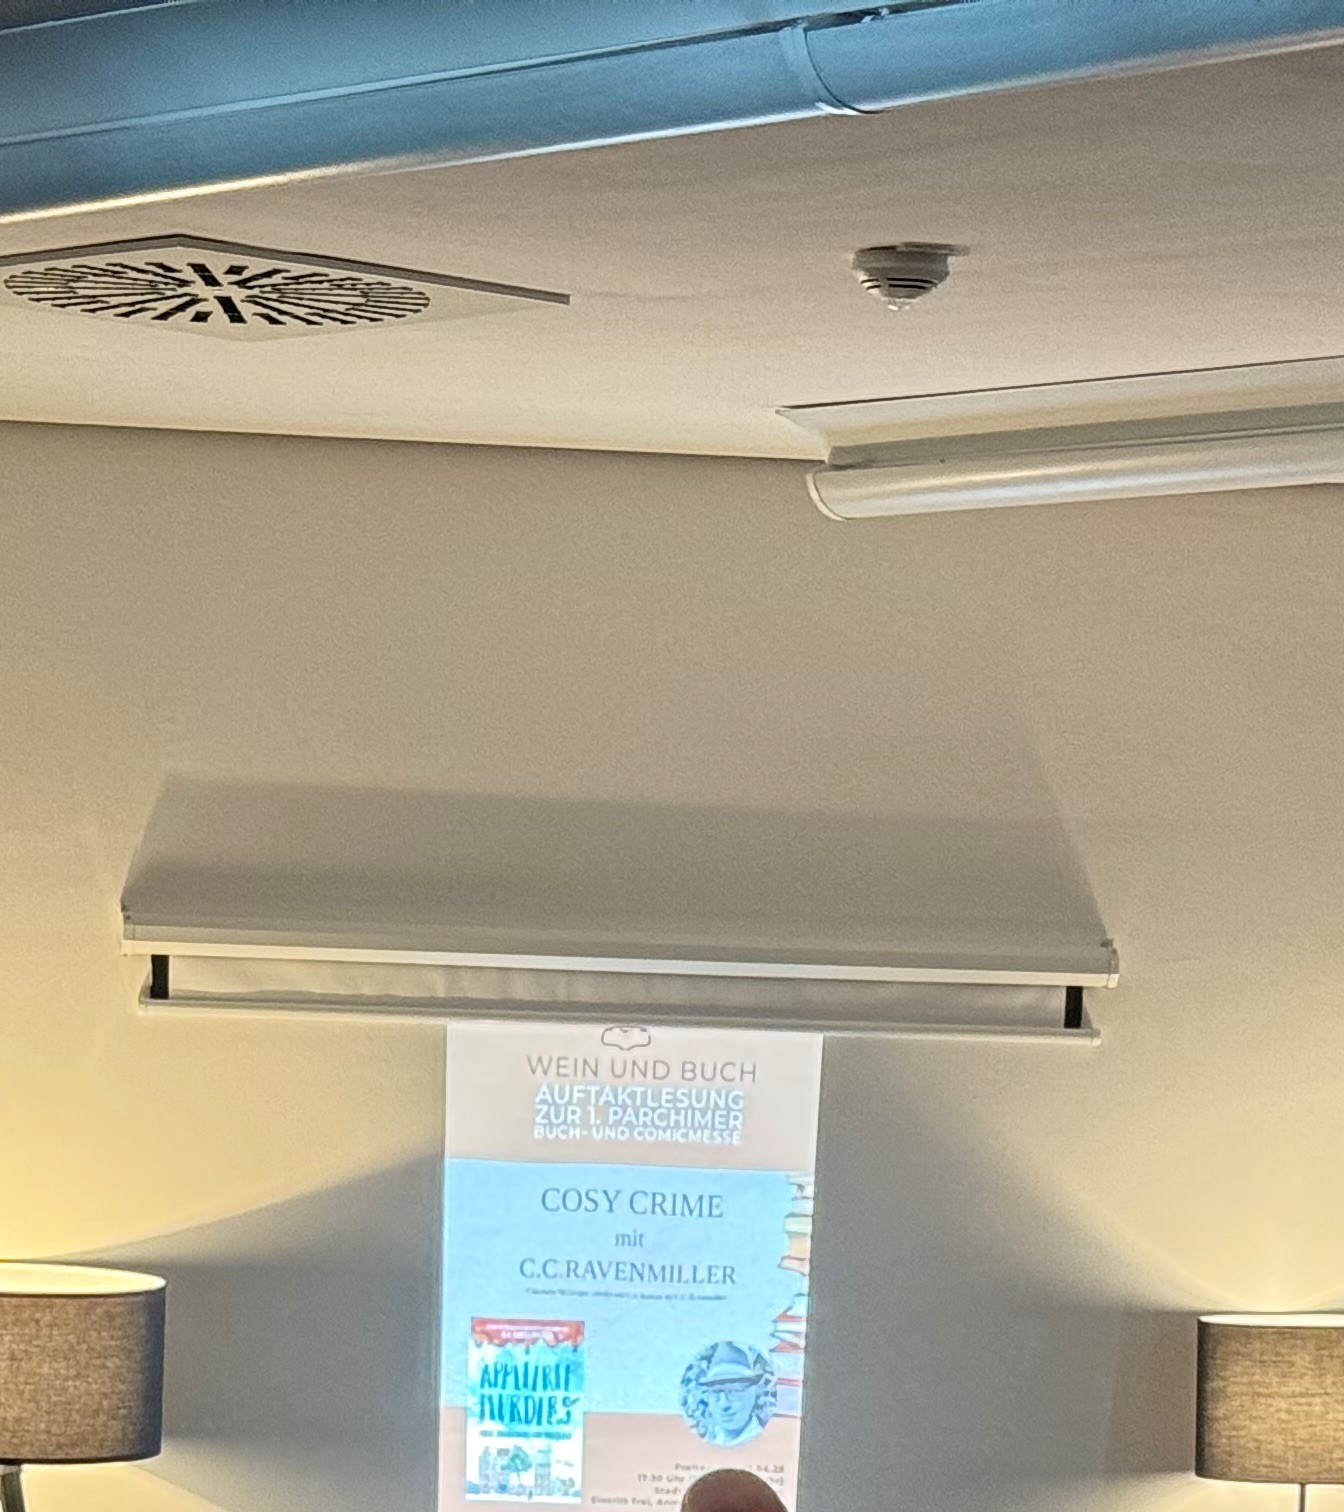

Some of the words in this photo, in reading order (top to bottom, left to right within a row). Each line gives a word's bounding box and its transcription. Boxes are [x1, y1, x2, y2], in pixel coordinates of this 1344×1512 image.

[526, 1055, 600, 1078] WEIN
[610, 1058, 670, 1082] UND
[681, 1060, 757, 1083] BUCH
[534, 1083, 745, 1111] AUFTAKTLESUNG
[534, 1105, 581, 1126] ZUR
[588, 1106, 603, 1126] 1.
[607, 1107, 744, 1130] PARCHIMER
[533, 1125, 588, 1141] BUCH-
[592, 1126, 630, 1142] UND
[633, 1127, 743, 1145] COMICMESSE
[541, 1187, 622, 1213] COSY
[629, 1189, 724, 1218] CRIME
[615, 1228, 644, 1248] mit
[519, 1257, 737, 1285] C.C.RAVENMILLER
